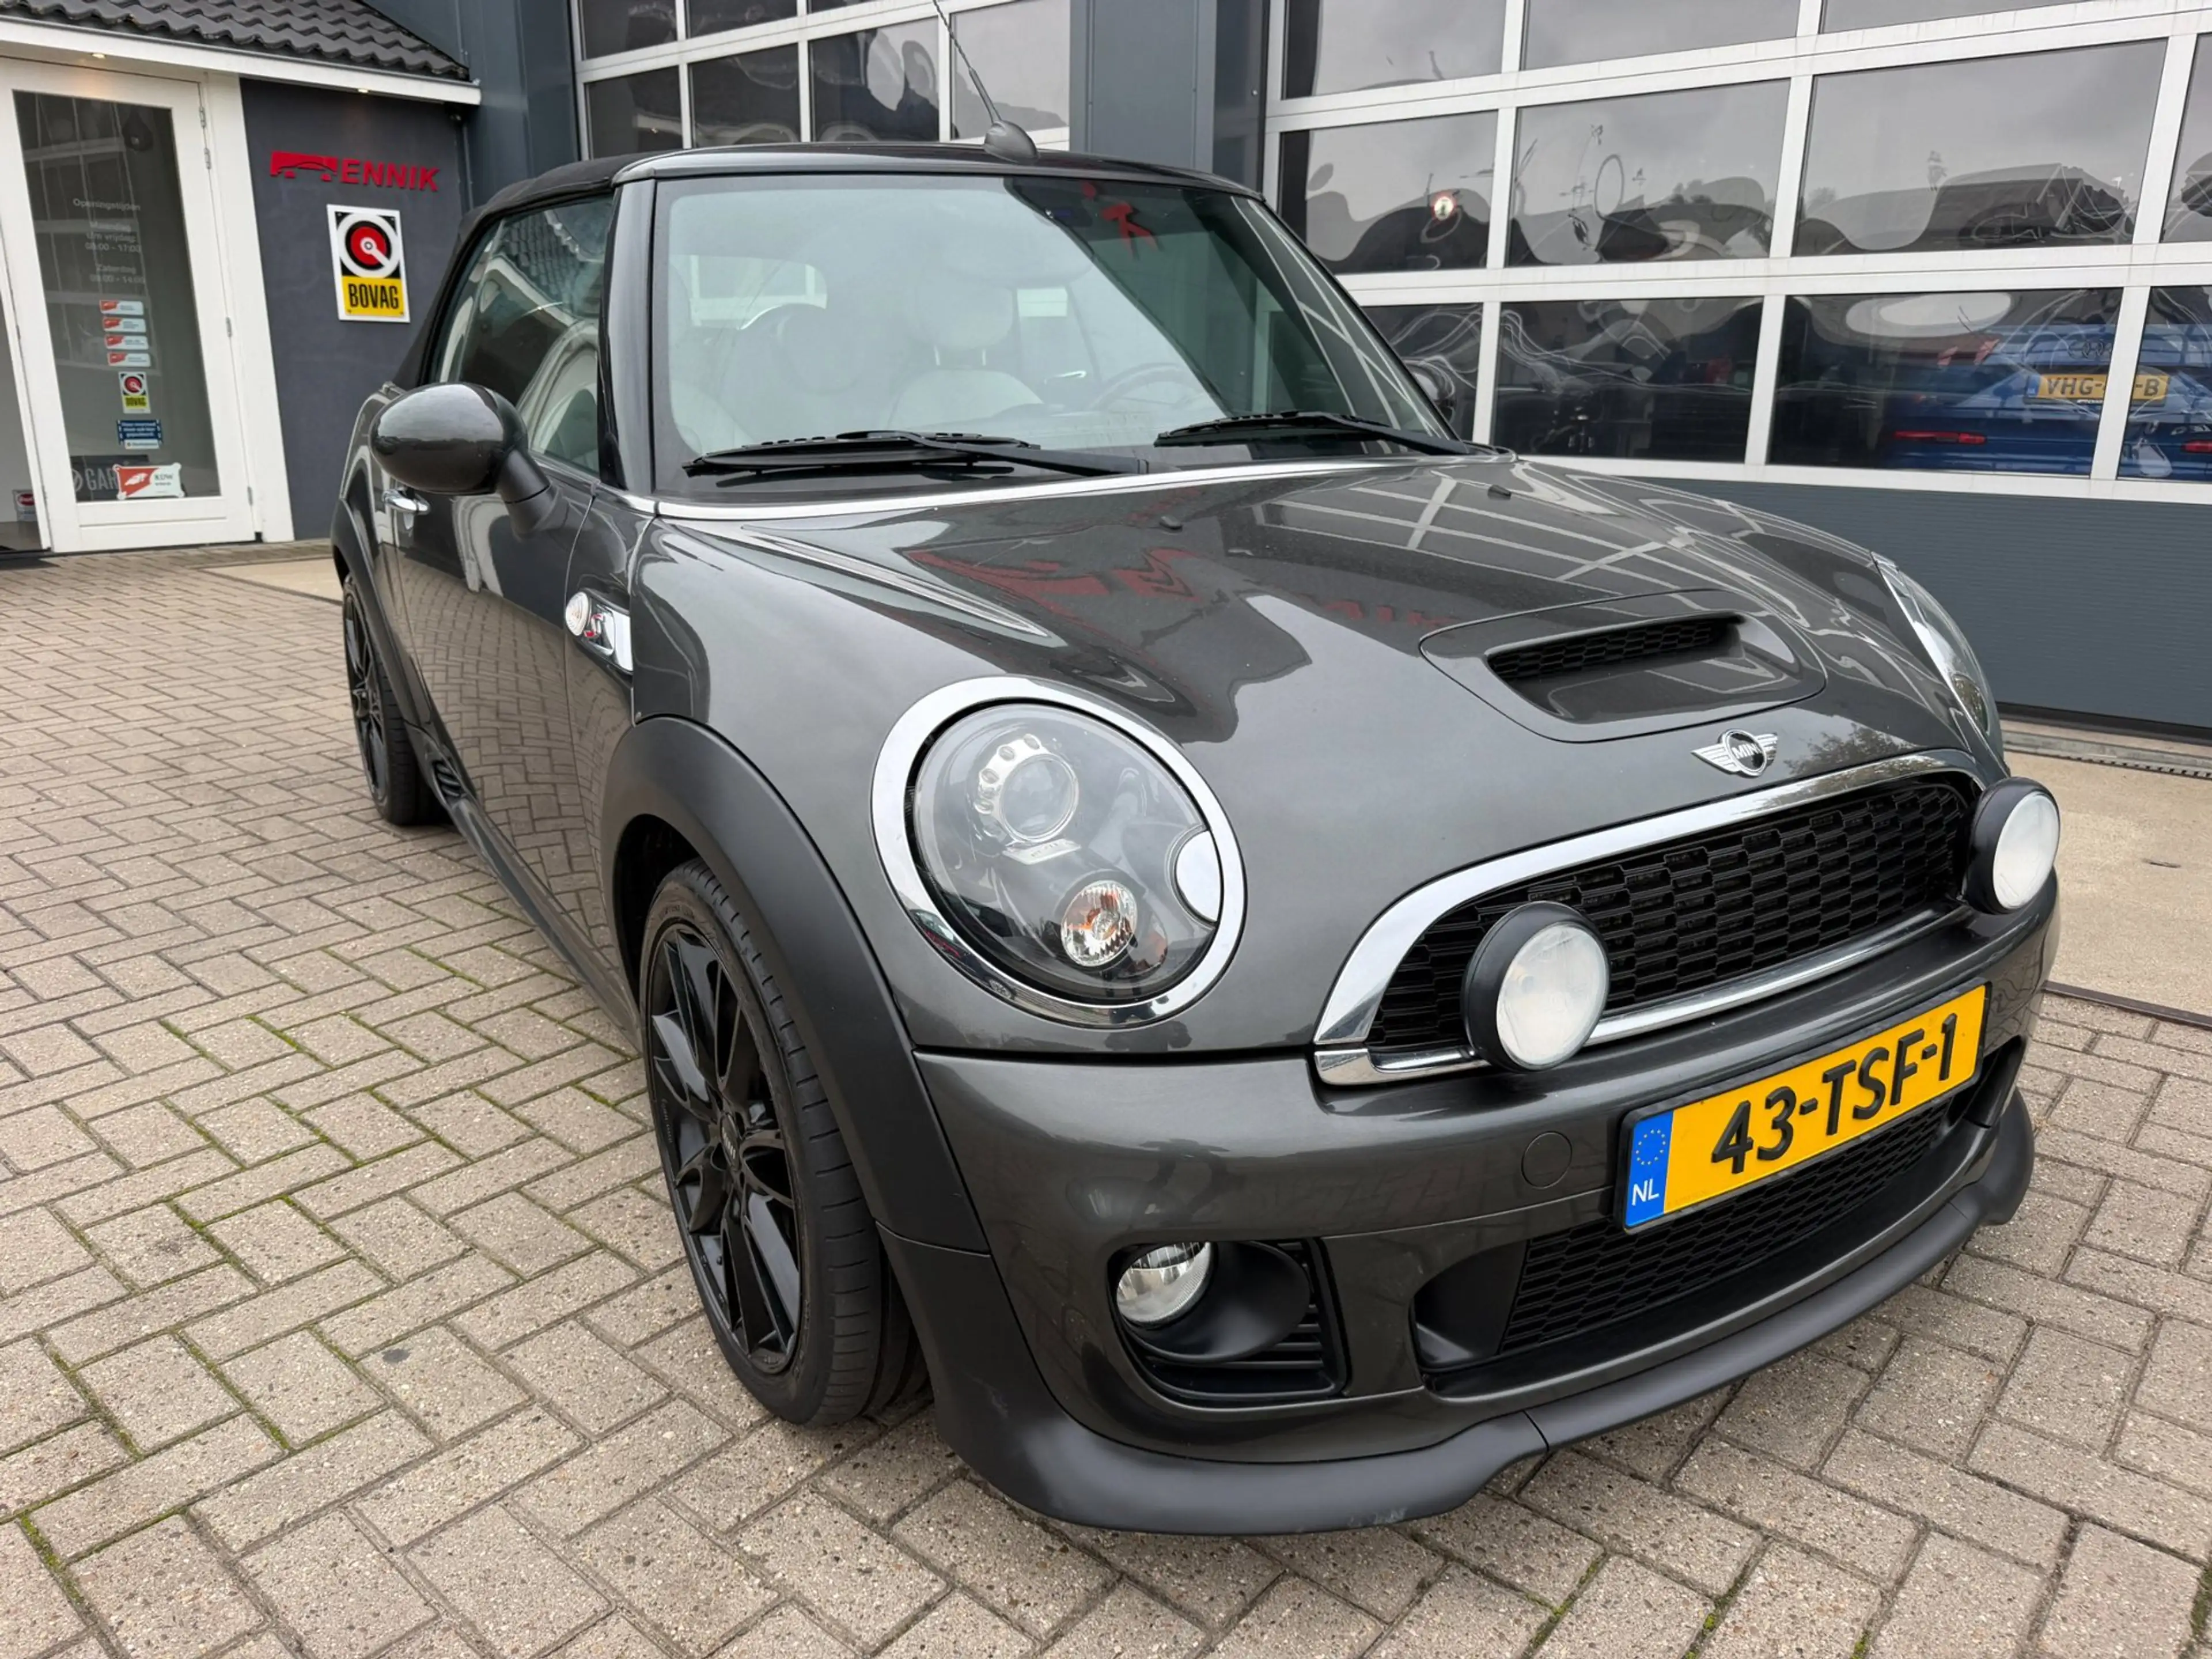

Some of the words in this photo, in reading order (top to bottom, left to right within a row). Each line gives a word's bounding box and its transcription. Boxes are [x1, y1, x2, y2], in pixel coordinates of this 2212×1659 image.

[348, 283, 399, 309] BOVAG
[2047, 377, 2160, 396] VHG--B
[1732, 743, 1763, 759] MINI
[1710, 1012, 1958, 1175] 43-TSF-1
[1631, 1177, 1660, 1206] NL
